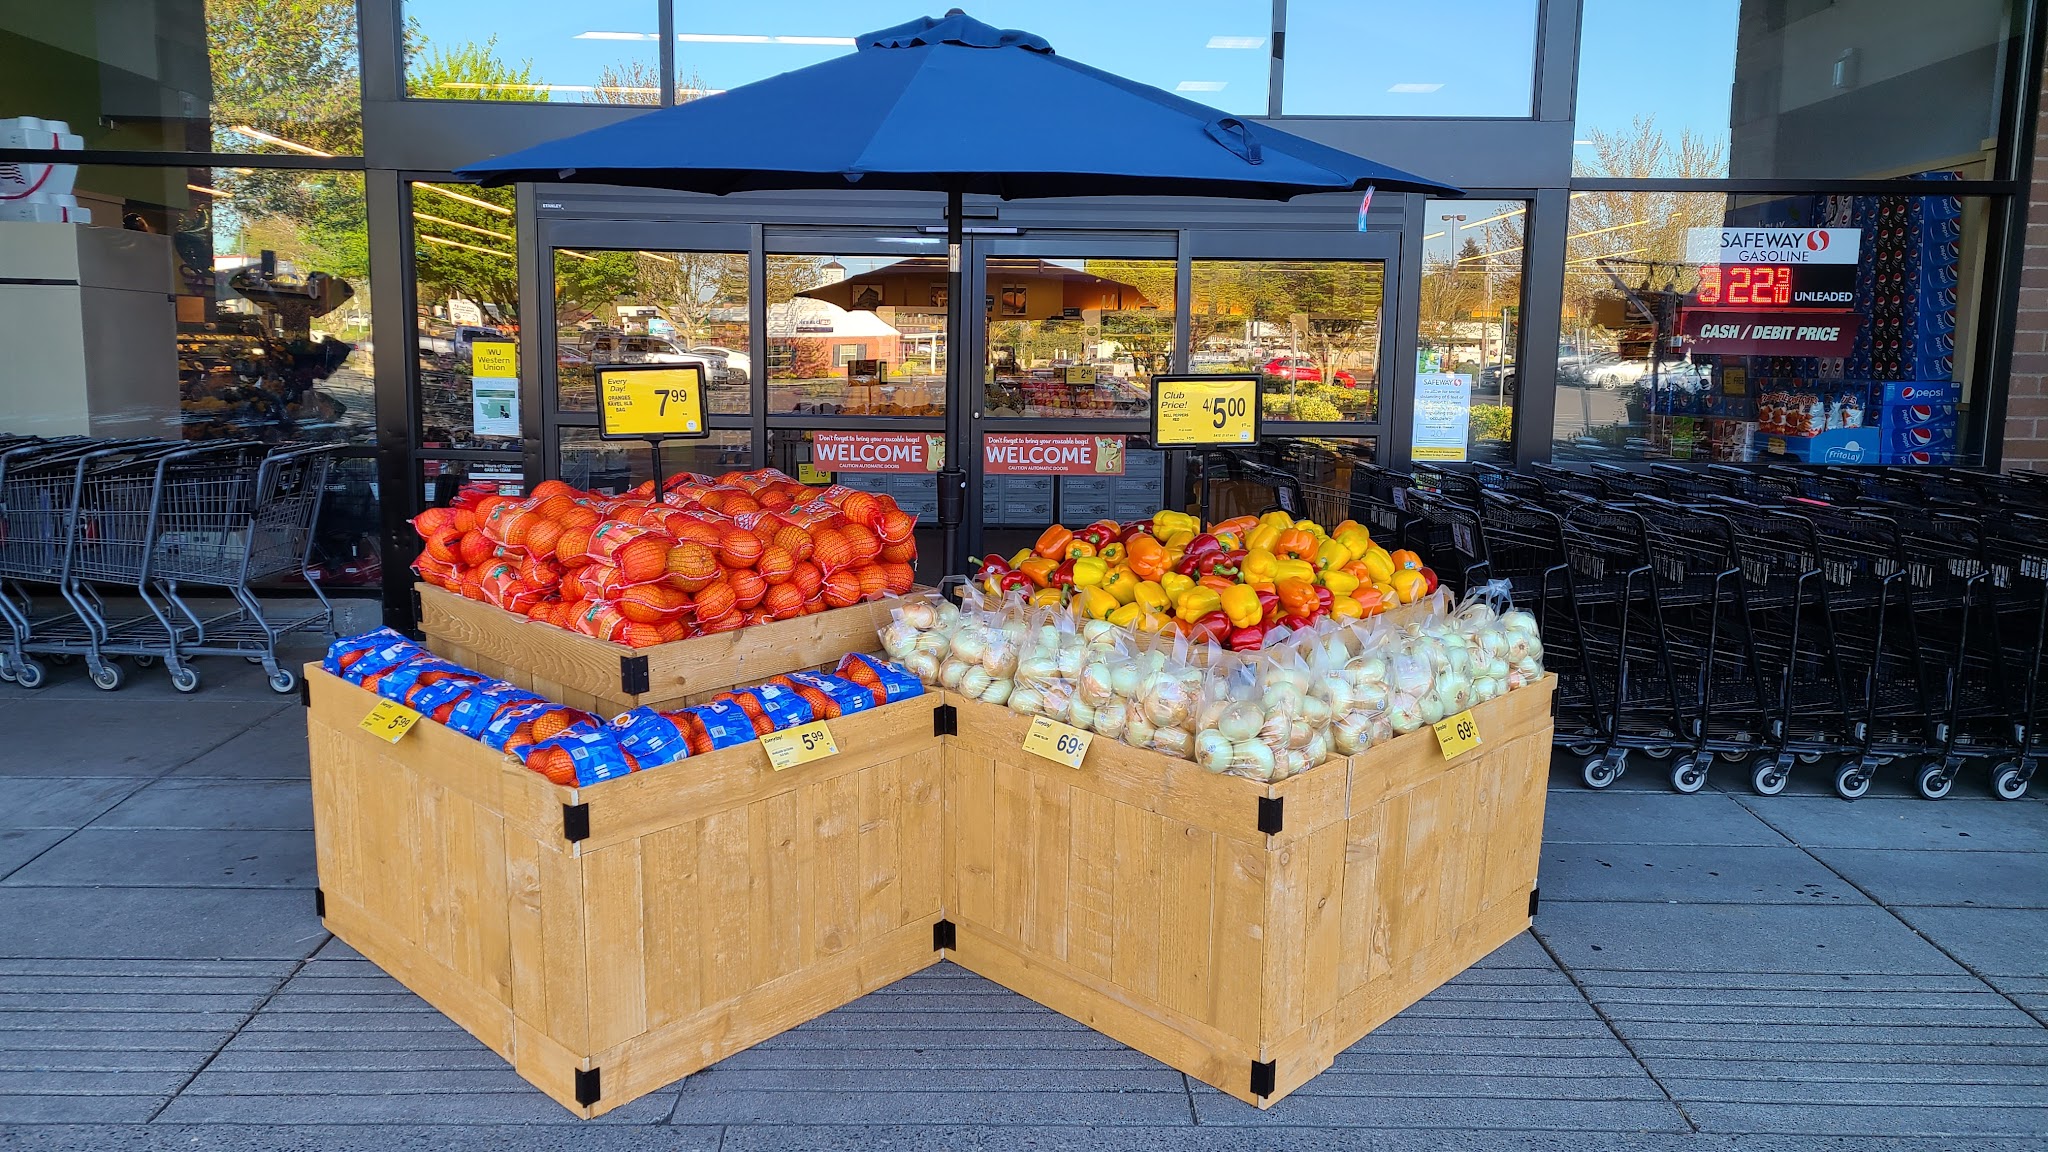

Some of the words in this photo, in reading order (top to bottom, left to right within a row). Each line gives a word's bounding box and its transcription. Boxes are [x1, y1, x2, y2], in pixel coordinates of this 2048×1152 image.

[1720, 232, 1805, 248] SAFEWAY
[1738, 250, 1809, 262] GASOLINE
[1794, 291, 1853, 302] UNLEADED
[1700, 323, 1741, 340] CASH
[1740, 324, 1753, 340] /
[1752, 325, 1796, 340] DEBIT
[1795, 327, 1841, 342] PRICE
[478, 356, 511, 364] Western
[1163, 391, 1185, 399] Club
[1916, 388, 1944, 398] pepsi
[1160, 401, 1188, 409] Price!
[834, 435, 849, 443] forget
[855, 435, 870, 443] bring
[905, 436, 920, 444] bags!
[988, 436, 1003, 444] Don't
[1003, 437, 1019, 445] forget
[1025, 437, 1039, 445] bring
[1039, 438, 1052, 446] your
[1052, 437, 1074, 445] reusable
[1074, 438, 1089, 446] bags!
[816, 443, 923, 462] WELCOME
[985, 446, 1092, 464] WELCOME
